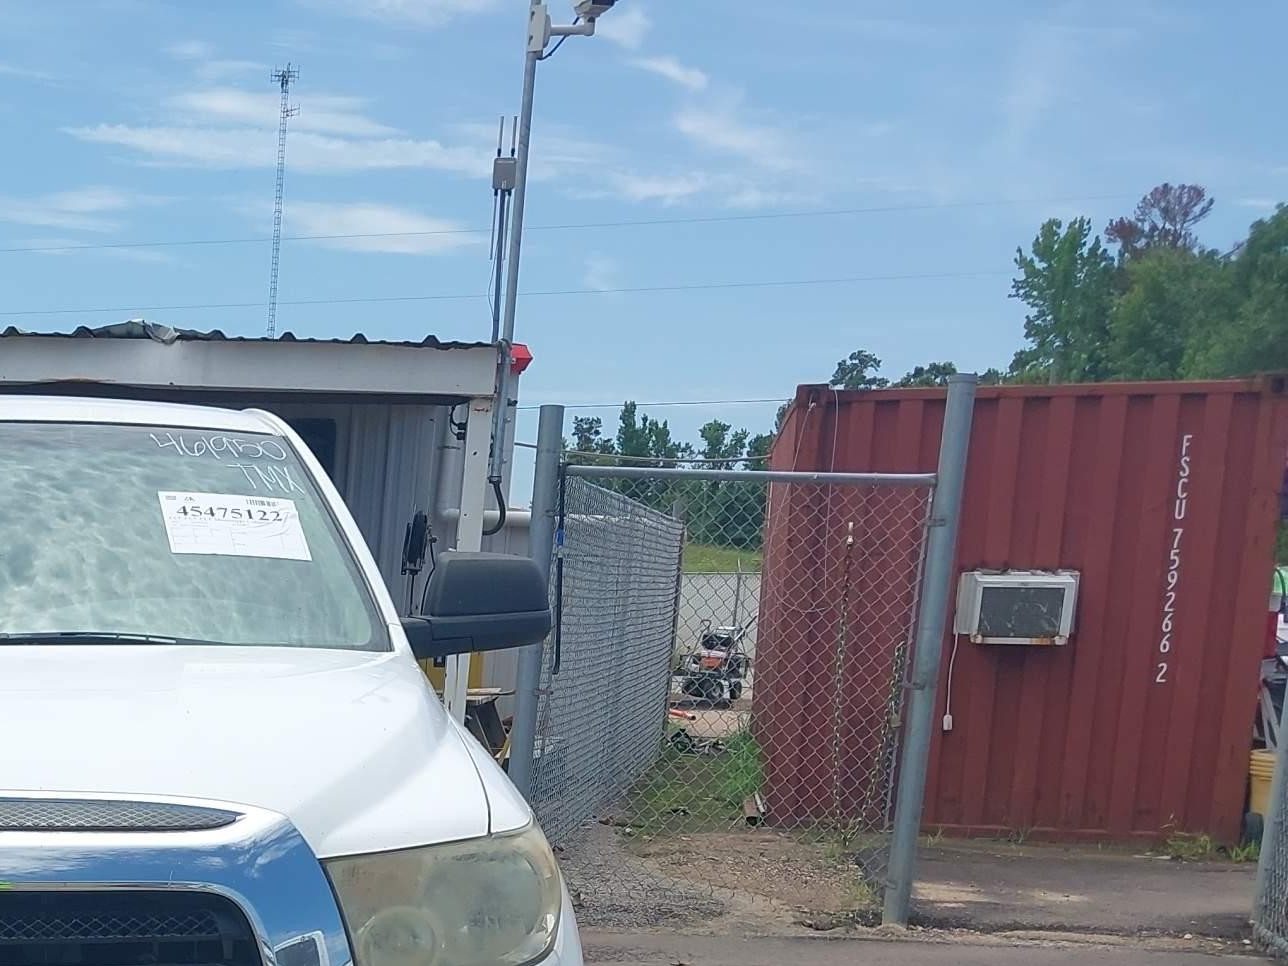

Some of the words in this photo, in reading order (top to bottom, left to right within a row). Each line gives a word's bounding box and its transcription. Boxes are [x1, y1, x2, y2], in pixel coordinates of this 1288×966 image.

[1175, 434, 1192, 519] FSCU
[176, 505, 283, 522] 45475122
[1160, 528, 1183, 653] 759266
[1155, 663, 1168, 682] 2
